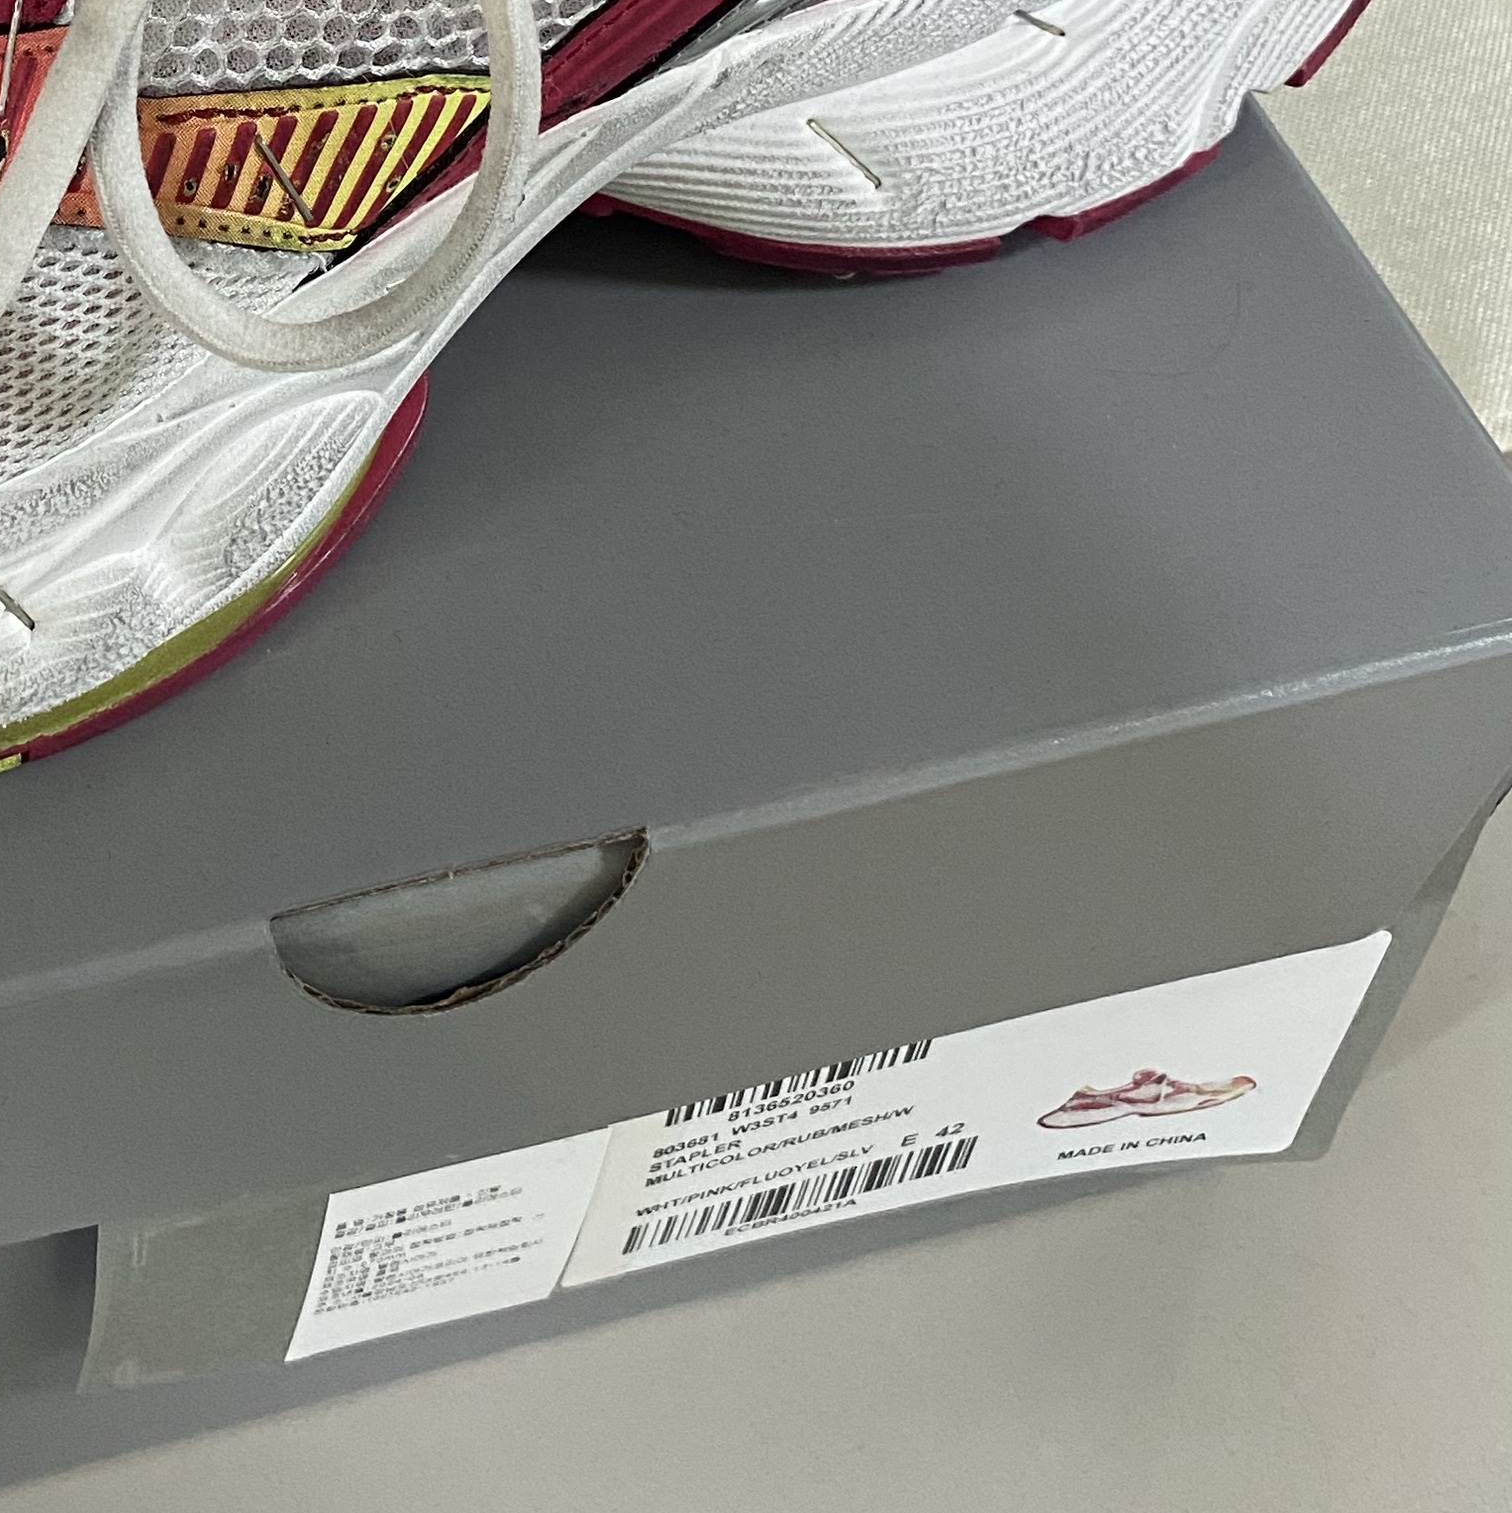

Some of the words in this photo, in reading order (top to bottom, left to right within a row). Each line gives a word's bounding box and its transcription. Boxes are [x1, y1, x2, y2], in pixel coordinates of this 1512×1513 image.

[728, 1080, 855, 1122] 8136520360
[732, 1110, 799, 1136] W3ST4
[808, 1095, 852, 1116] 9571
[648, 1139, 742, 1173] STAPLER
[1057, 1143, 1115, 1160] MADE
[1120, 1140, 1140, 1151] IN
[1146, 1132, 1207, 1148] CHINA
[636, 1144, 874, 1217] WHT/PINK/FLUOYEL/SLV
[900, 1132, 919, 1148] E
[935, 1122, 966, 1138] 42
